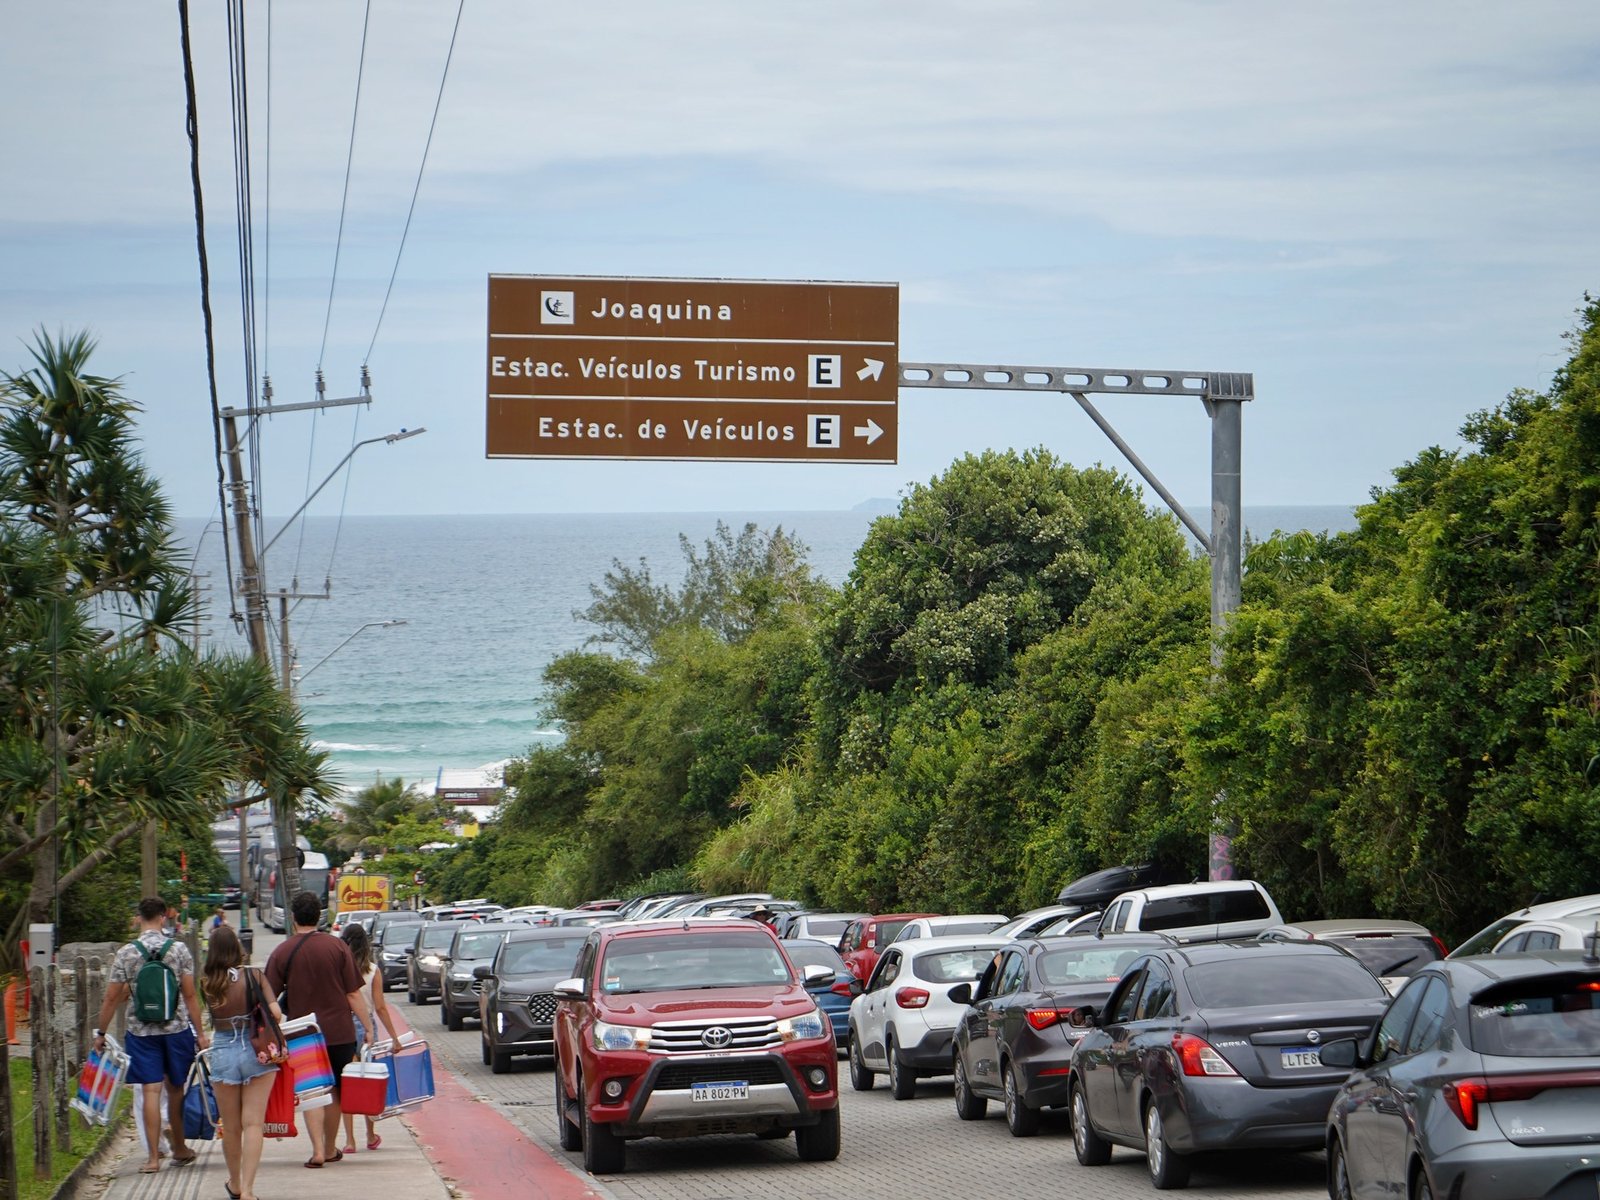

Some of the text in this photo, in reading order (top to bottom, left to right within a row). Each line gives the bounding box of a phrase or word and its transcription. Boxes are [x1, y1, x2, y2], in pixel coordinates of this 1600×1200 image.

[592, 298, 732, 324] Joaquina
[491, 356, 833, 385] Estac. Veículos Turismo E
[539, 417, 832, 445] Estac. de Veículos E
[1215, 1040, 1248, 1048] VERSA
[1287, 1052, 1319, 1067] LTE8
[695, 1087, 747, 1101] AA 802 PW
